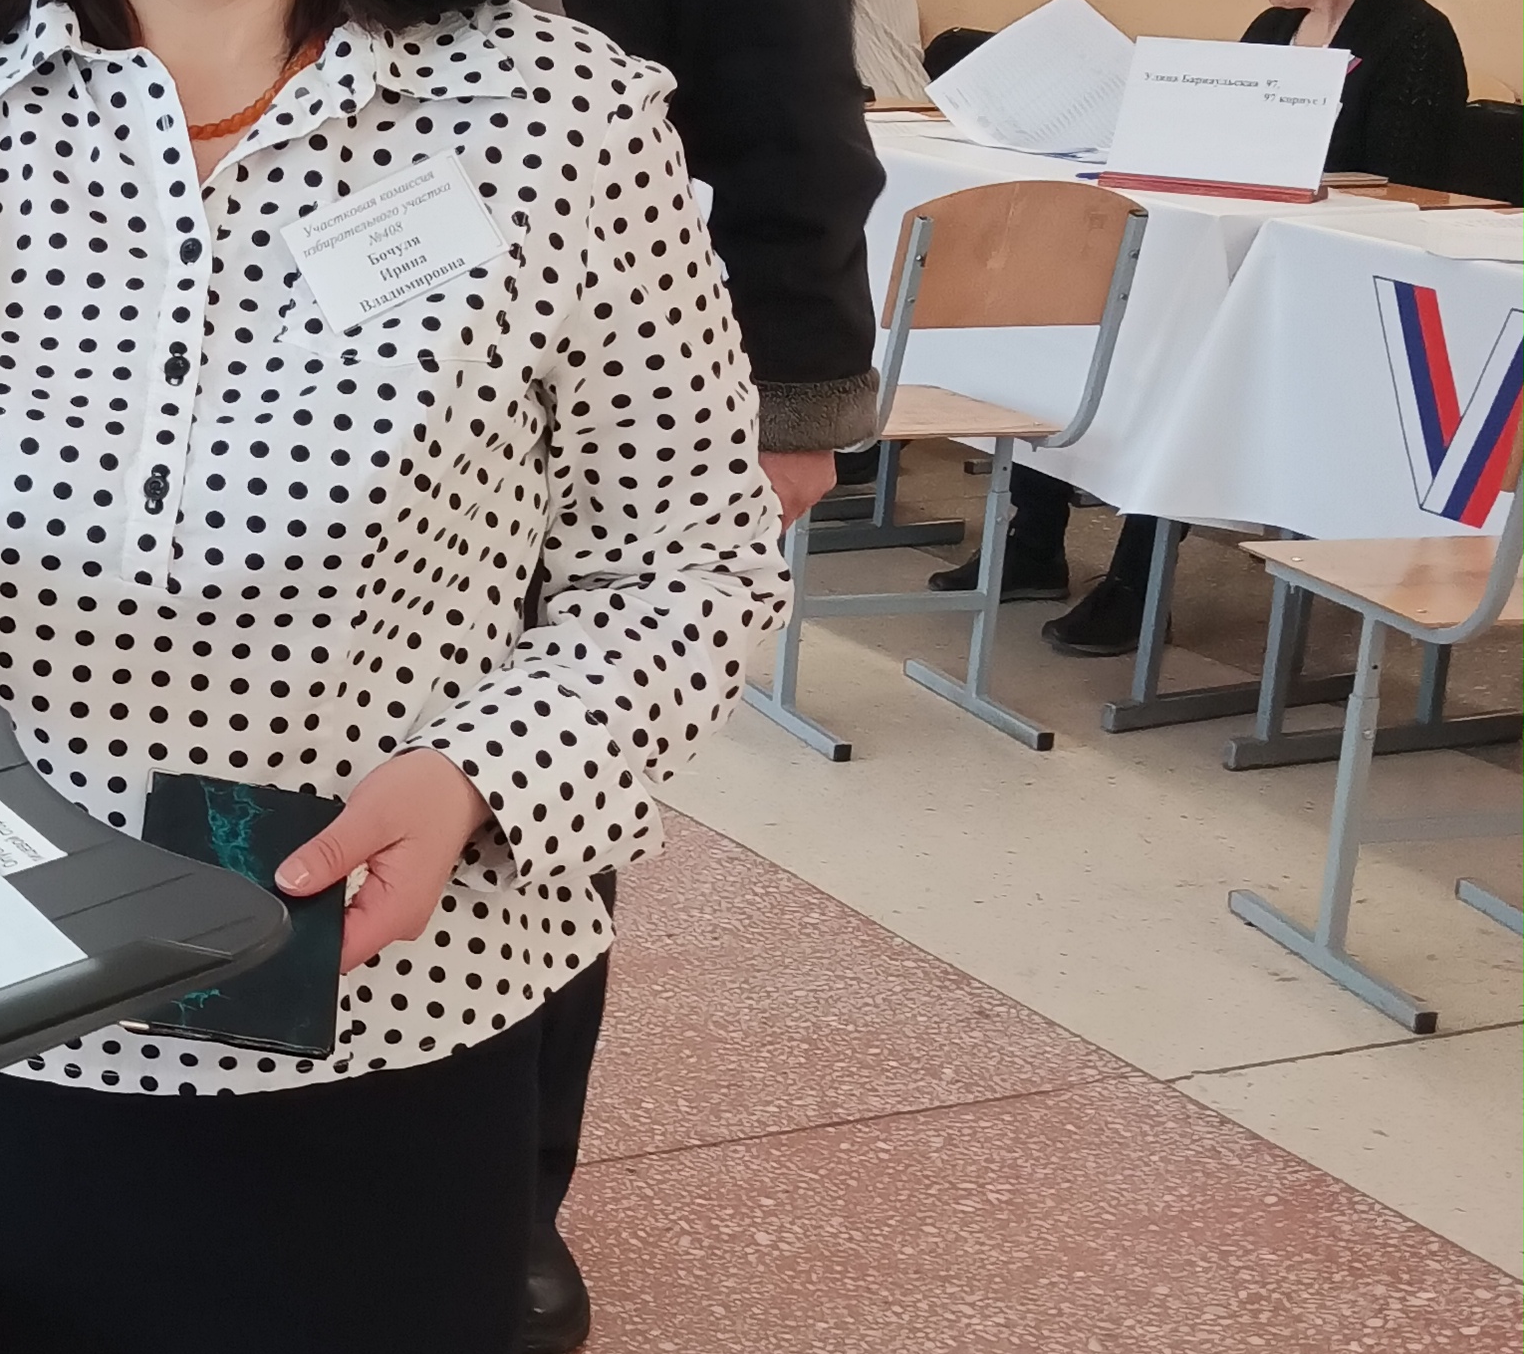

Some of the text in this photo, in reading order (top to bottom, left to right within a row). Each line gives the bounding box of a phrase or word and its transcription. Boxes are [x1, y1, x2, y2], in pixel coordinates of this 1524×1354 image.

[1144, 71, 1178, 83] Улица
[1181, 74, 1260, 88] Барнаульская
[1263, 93, 1277, 103] 97
[1279, 95, 1319, 107] корпус
[302, 181, 452, 260] избирательного участка
[303, 169, 436, 240] Участковая комиссия
[366, 235, 422, 268] Бочуля
[378, 253, 428, 283] Ирина
[358, 255, 467, 314] Владимировна
